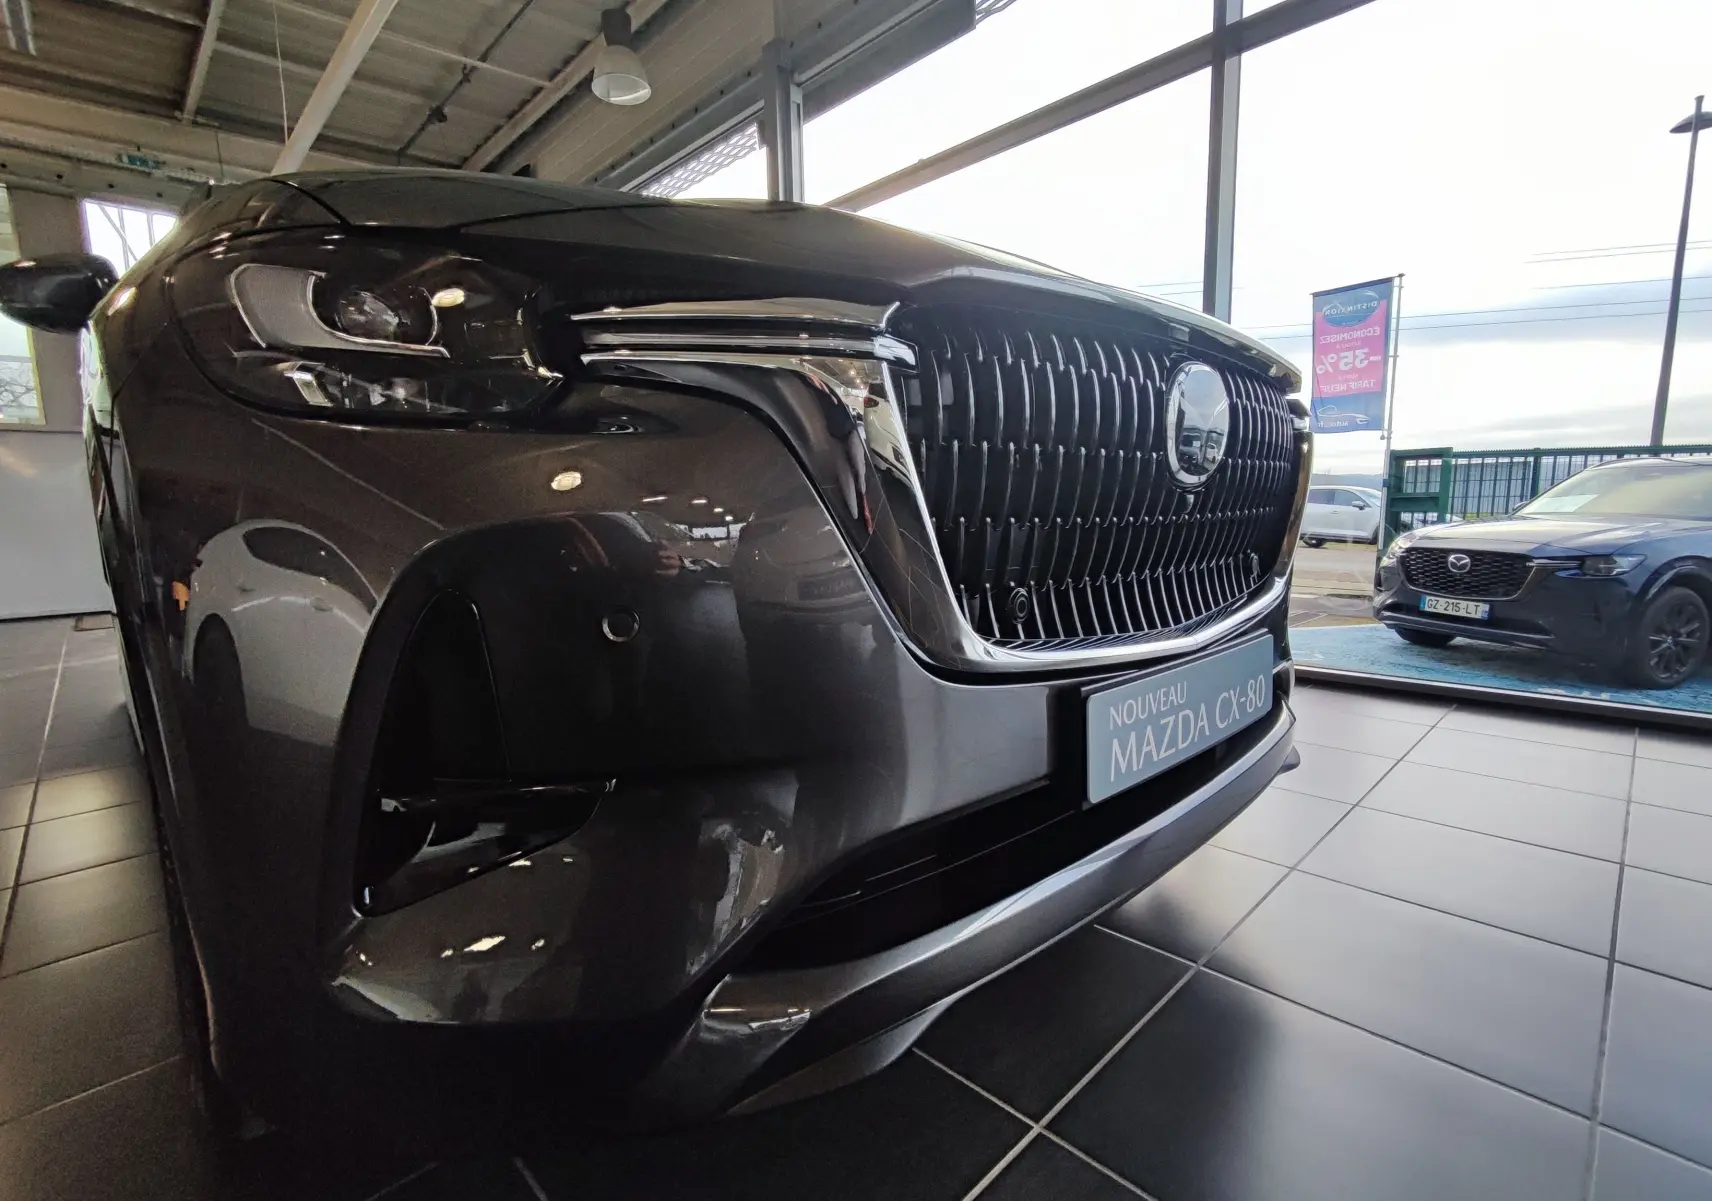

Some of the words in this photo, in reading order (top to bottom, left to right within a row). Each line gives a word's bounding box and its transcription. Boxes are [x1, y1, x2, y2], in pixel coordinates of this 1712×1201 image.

[1427, 598, 1480, 615] GZ-215-LT
[1109, 681, 1187, 730] NOUVEAU
[1110, 702, 1210, 782] MAZDA
[1215, 674, 1266, 729] CX-80
